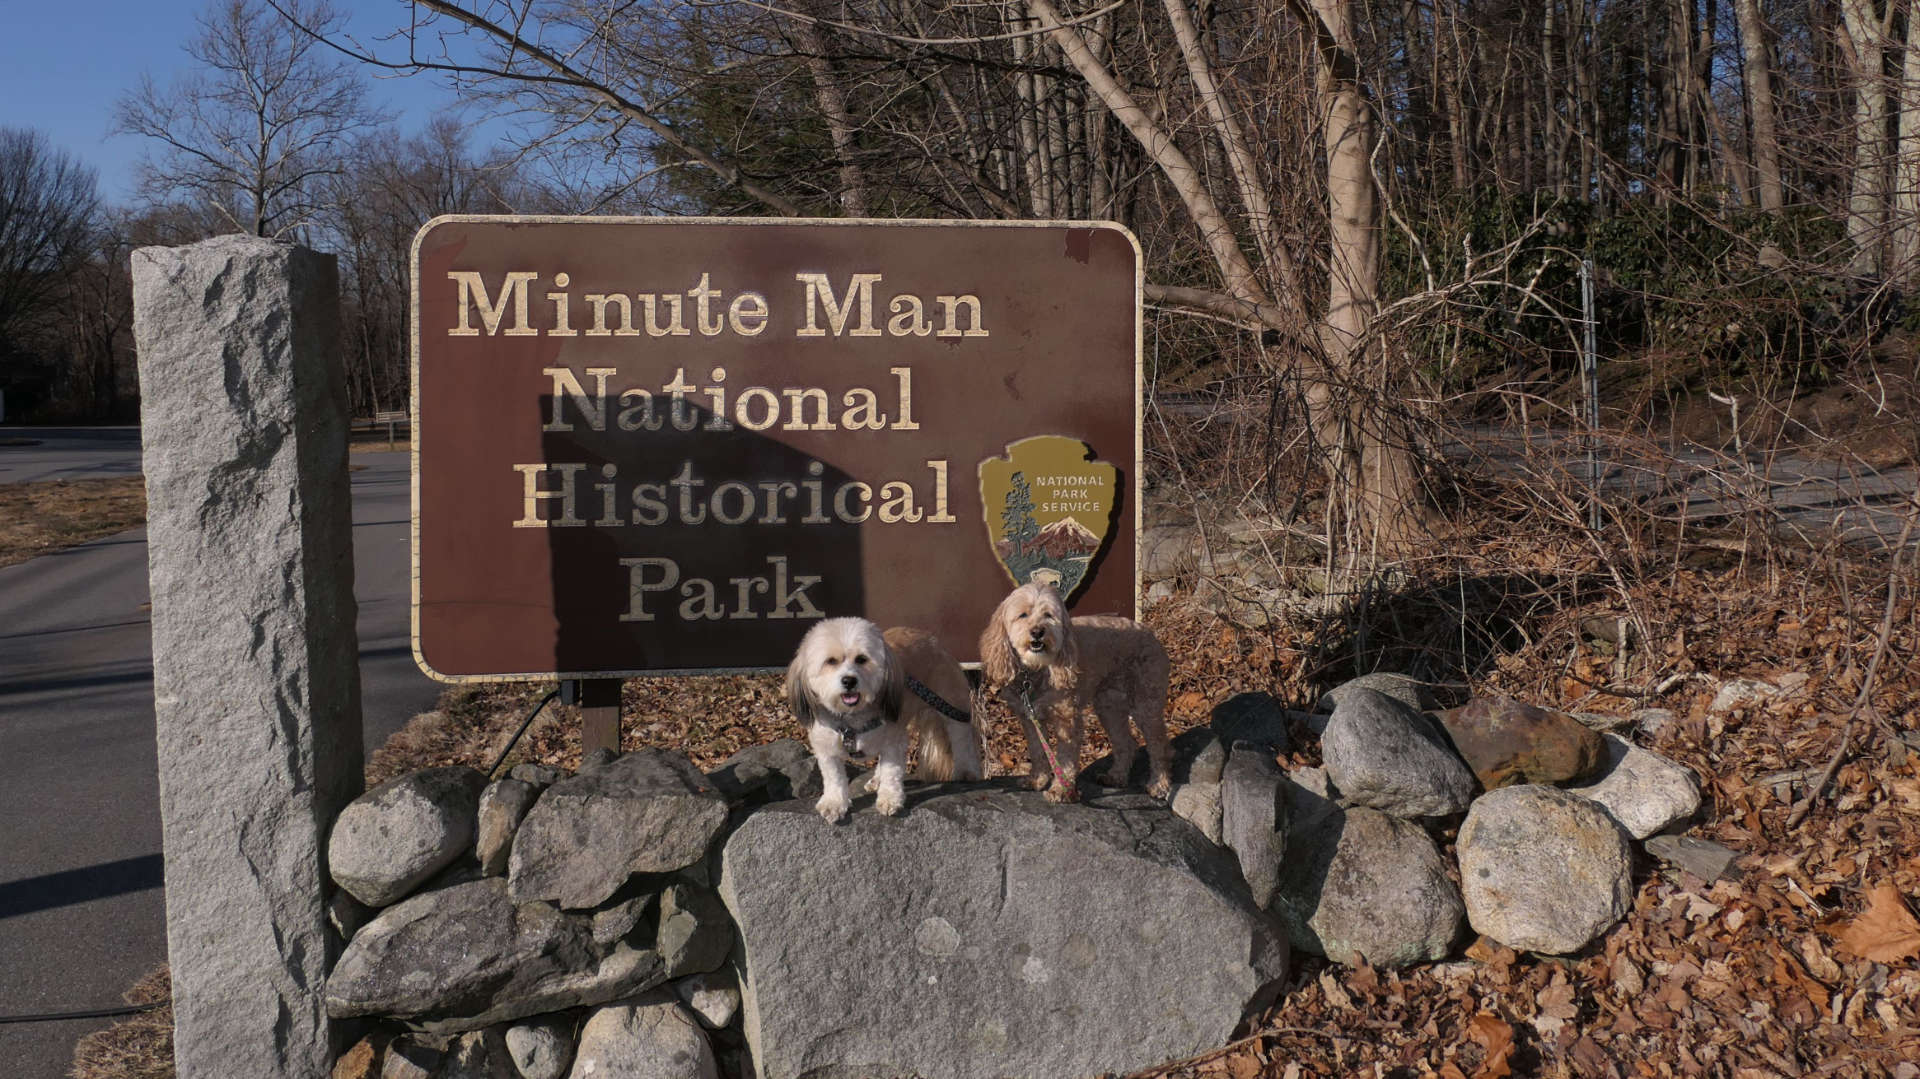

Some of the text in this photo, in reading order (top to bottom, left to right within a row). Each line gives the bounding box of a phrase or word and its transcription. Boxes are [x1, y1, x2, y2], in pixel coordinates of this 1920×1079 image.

[447, 272, 989, 337] Minute Man
[543, 368, 920, 431] National
[513, 461, 956, 528] Historical
[1037, 476, 1104, 486] NATIONAL
[1042, 502, 1100, 512] SERVICE
[1053, 489, 1088, 499] PARK
[619, 556, 824, 621] Park
